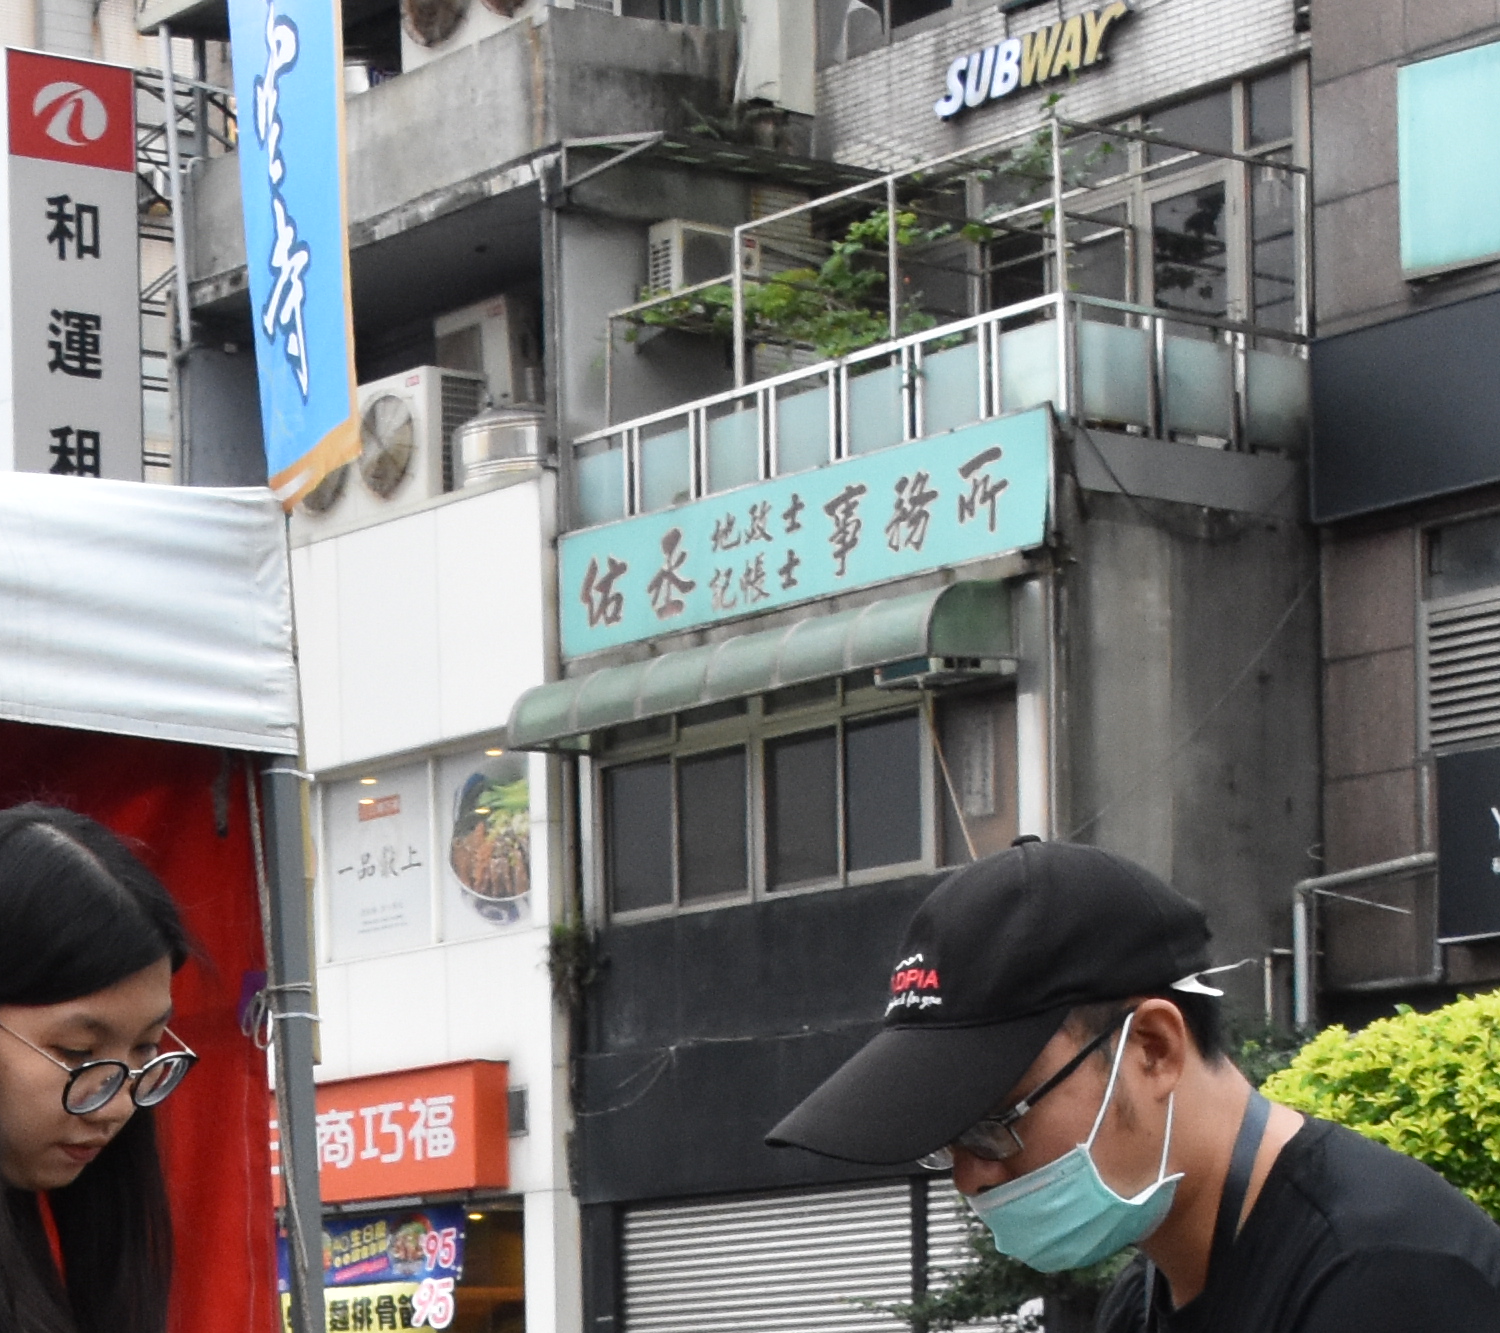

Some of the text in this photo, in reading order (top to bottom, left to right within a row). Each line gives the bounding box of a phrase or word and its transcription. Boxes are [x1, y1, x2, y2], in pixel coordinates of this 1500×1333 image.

[933, 1, 1128, 118] SUBWAY
[710, 492, 806, 554] 地政士
[824, 446, 1008, 578] 事務所
[269, 1095, 456, 1176] 商巧福
[423, 1228, 457, 1271] 95
[412, 1277, 454, 1329] 95
